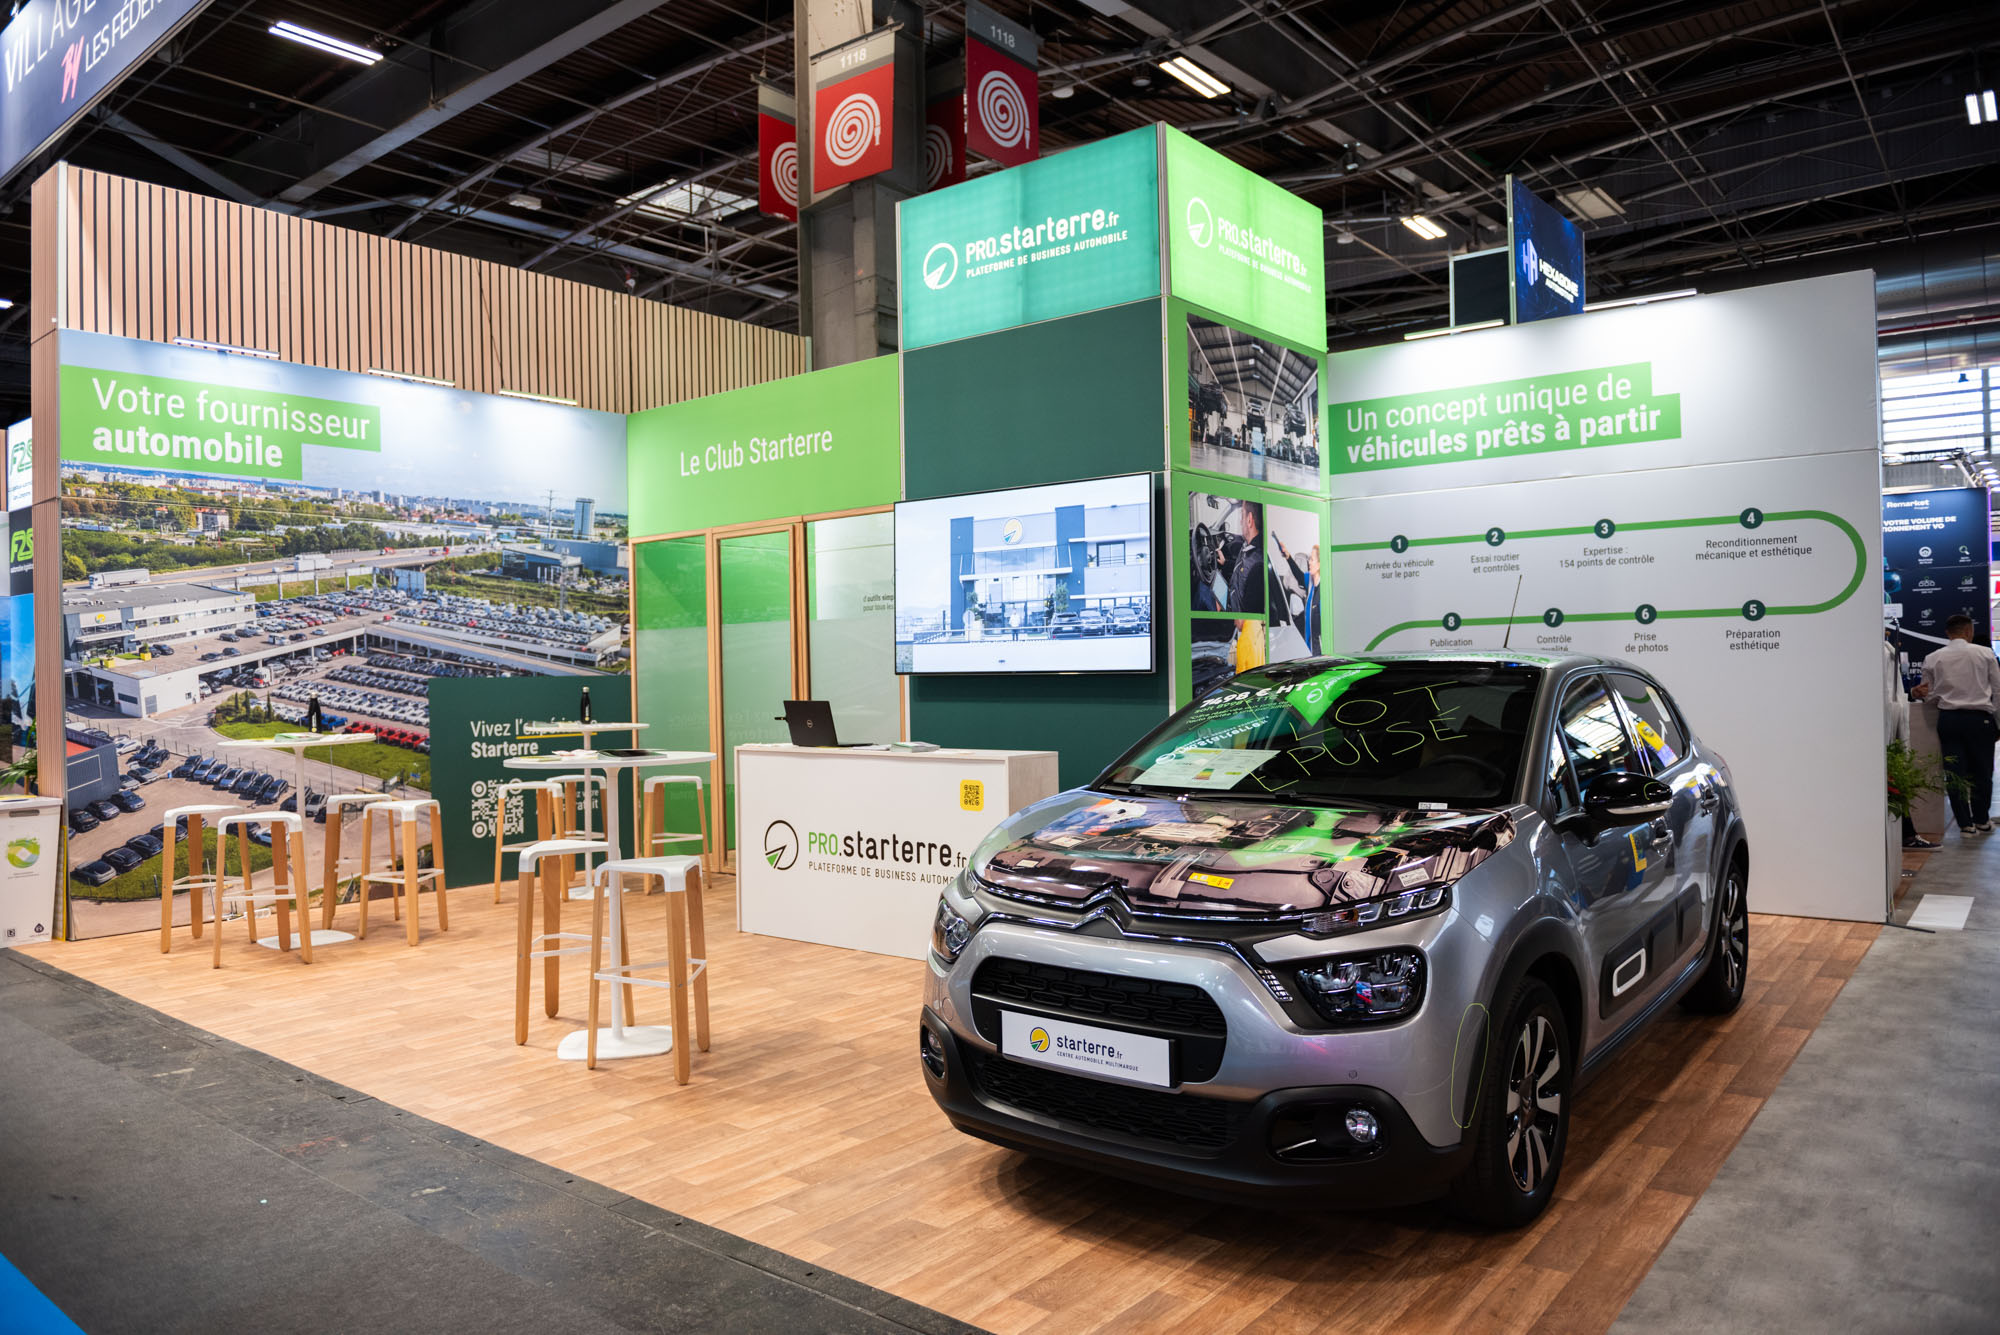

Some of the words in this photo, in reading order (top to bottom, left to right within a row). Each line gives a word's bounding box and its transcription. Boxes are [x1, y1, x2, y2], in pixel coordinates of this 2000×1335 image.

[991, 25, 1015, 49] 1118
[85, 24, 110, 73] LES
[839, 48, 867, 69] 1118
[966, 209, 1119, 264] PRO.starterre.fr
[966, 258, 1015, 279] PLATEFORME
[1017, 254, 1028, 266] DE
[1031, 244, 1071, 263] BUSINESS
[1073, 230, 1128, 252] AUTOMOBILE
[92, 377, 185, 419] Votre
[196, 389, 370, 440] fournisseur
[1347, 407, 1377, 433] Un
[1385, 391, 1487, 428] concept
[1496, 381, 1588, 416] unique
[1597, 372, 1632, 402] de
[1347, 429, 1468, 464] véhicules
[1475, 420, 1546, 456] prêts
[1555, 414, 1570, 442] à
[1579, 404, 1661, 446] partir
[92, 425, 283, 468] automobile
[680, 452, 700, 477] Le
[705, 440, 744, 472] Club
[749, 430, 833, 464] Starterre
[1746, 512, 1755, 524] 4
[1883, 518, 1909, 527] VOTRE
[1910, 516, 1944, 525] VOLUME
[1600, 523, 1609, 534] 3
[1491, 531, 1499, 542] 2
[1705, 535, 1798, 549] Reconditionnement
[1470, 554, 1491, 564] Essai
[1494, 552, 1520, 562] routier
[1583, 546, 1623, 557] Expertise
[1695, 548, 1747, 561] mécanique
[1749, 549, 1759, 558] et
[1761, 545, 1812, 558] esthétique
[1365, 560, 1391, 570] Arrivée
[1392, 560, 1402, 569] du
[1404, 558, 1434, 568] véhicule
[1559, 559, 1575, 569] 154
[1577, 557, 1603, 569] points
[1605, 556, 1616, 566] de
[1618, 553, 1655, 565] contrôle
[1473, 566, 1481, 574] et
[1483, 562, 1520, 573] contrôles
[1381, 571, 1393, 580] sur
[1395, 570, 1401, 578] le
[1403, 571, 1420, 580] parc
[1641, 608, 1650, 620] 6
[1749, 604, 1758, 616] 5
[1447, 616, 1455, 627] 8
[1550, 611, 1558, 624] 7
[1536, 634, 1572, 644] Contrôle
[1634, 632, 1657, 643] Prise
[1725, 629, 1781, 642] Préparation
[1430, 638, 1473, 648] Publication
[1625, 643, 1636, 653] de
[1638, 642, 1669, 654] photos
[1729, 640, 1780, 652] esthétique
[470, 719, 511, 738] Vivez
[471, 741, 539, 759] Starterre
[808, 830, 967, 869] PRO.starterre.fr
[808, 860, 858, 876] PLATEFORME
[861, 866, 871, 877] DE
[875, 868, 917, 882] BUSINESS
[1056, 1035, 1124, 1060] starterre.fr
[1056, 1051, 1074, 1060] CENTRE
[1075, 1054, 1104, 1065] AUTOMOBILE
[1105, 1060, 1139, 1072] MULTIMARQUE
